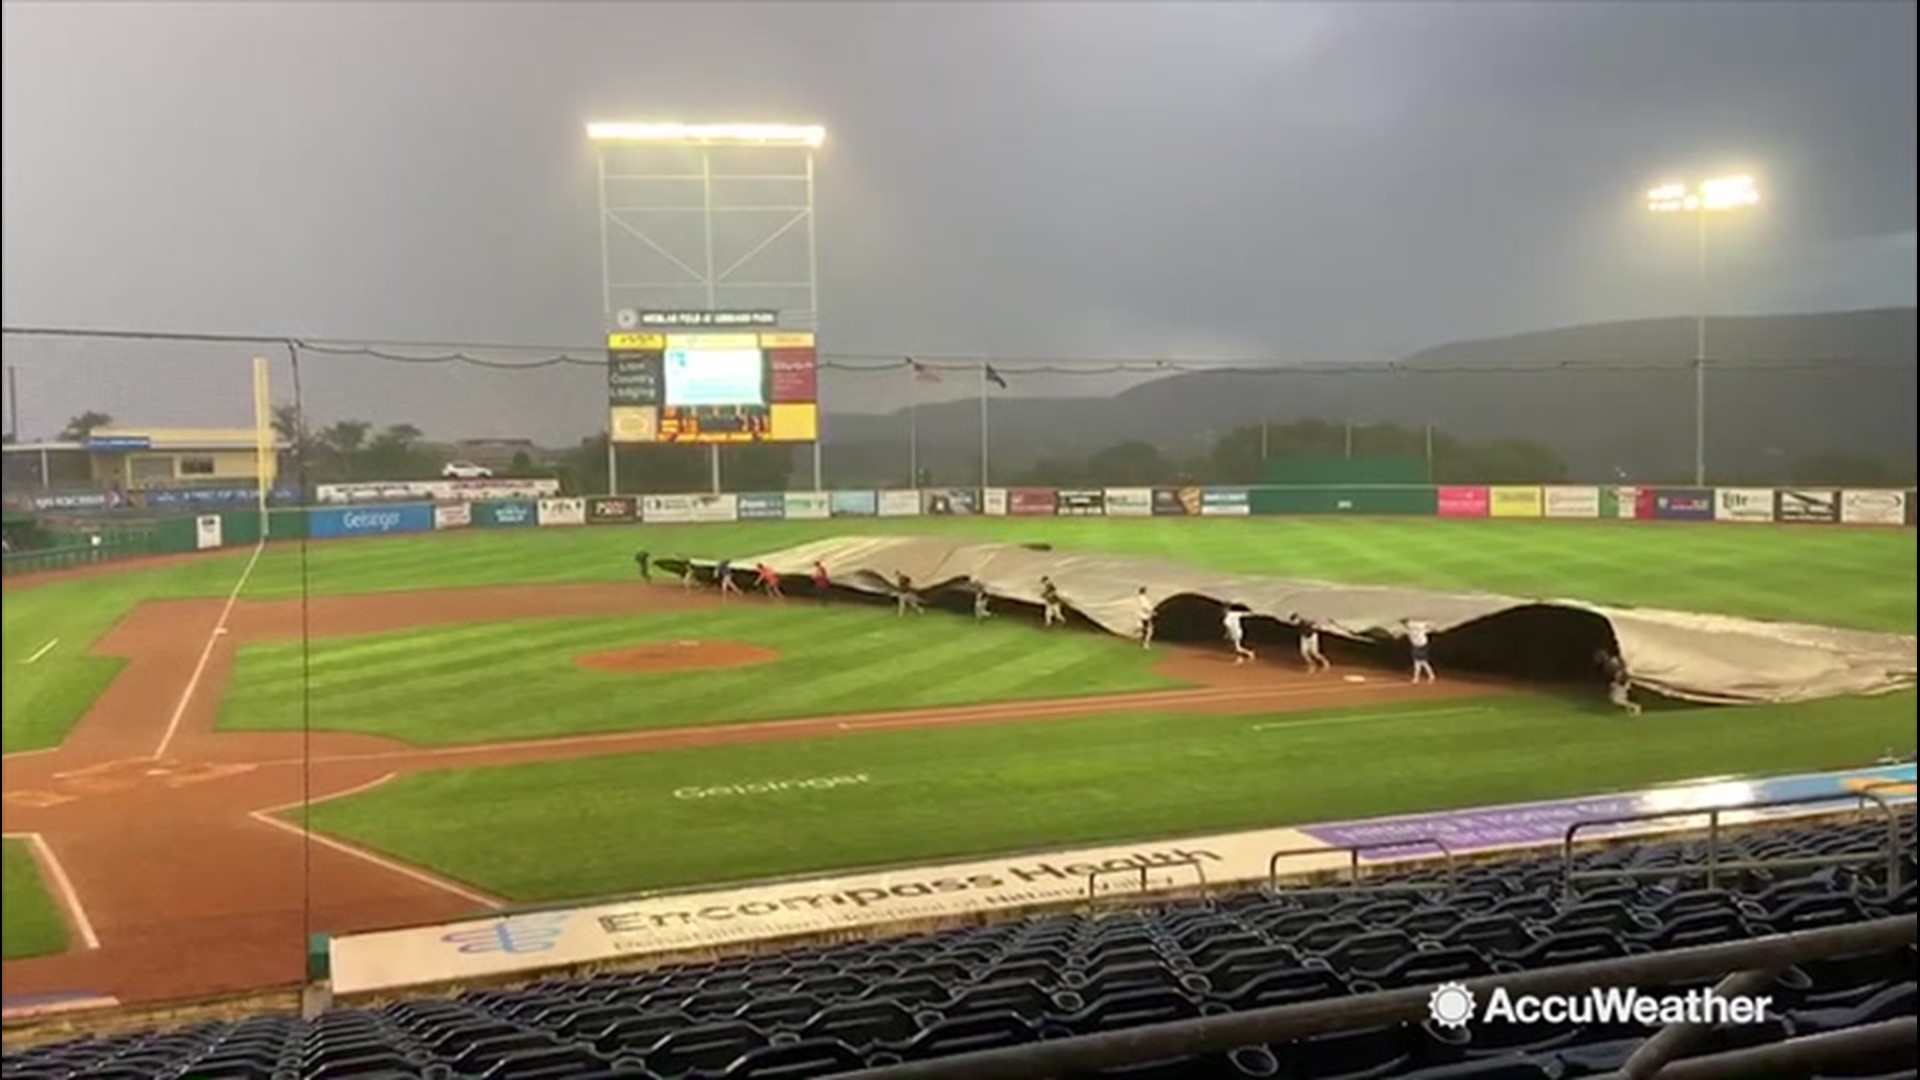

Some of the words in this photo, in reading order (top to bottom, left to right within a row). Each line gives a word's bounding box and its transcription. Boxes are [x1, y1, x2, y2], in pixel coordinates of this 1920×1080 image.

[342, 510, 401, 531] Geisinger
[673, 773, 870, 801] Geisinger
[597, 873, 1004, 934] Encompass
[1007, 847, 1224, 883] Health
